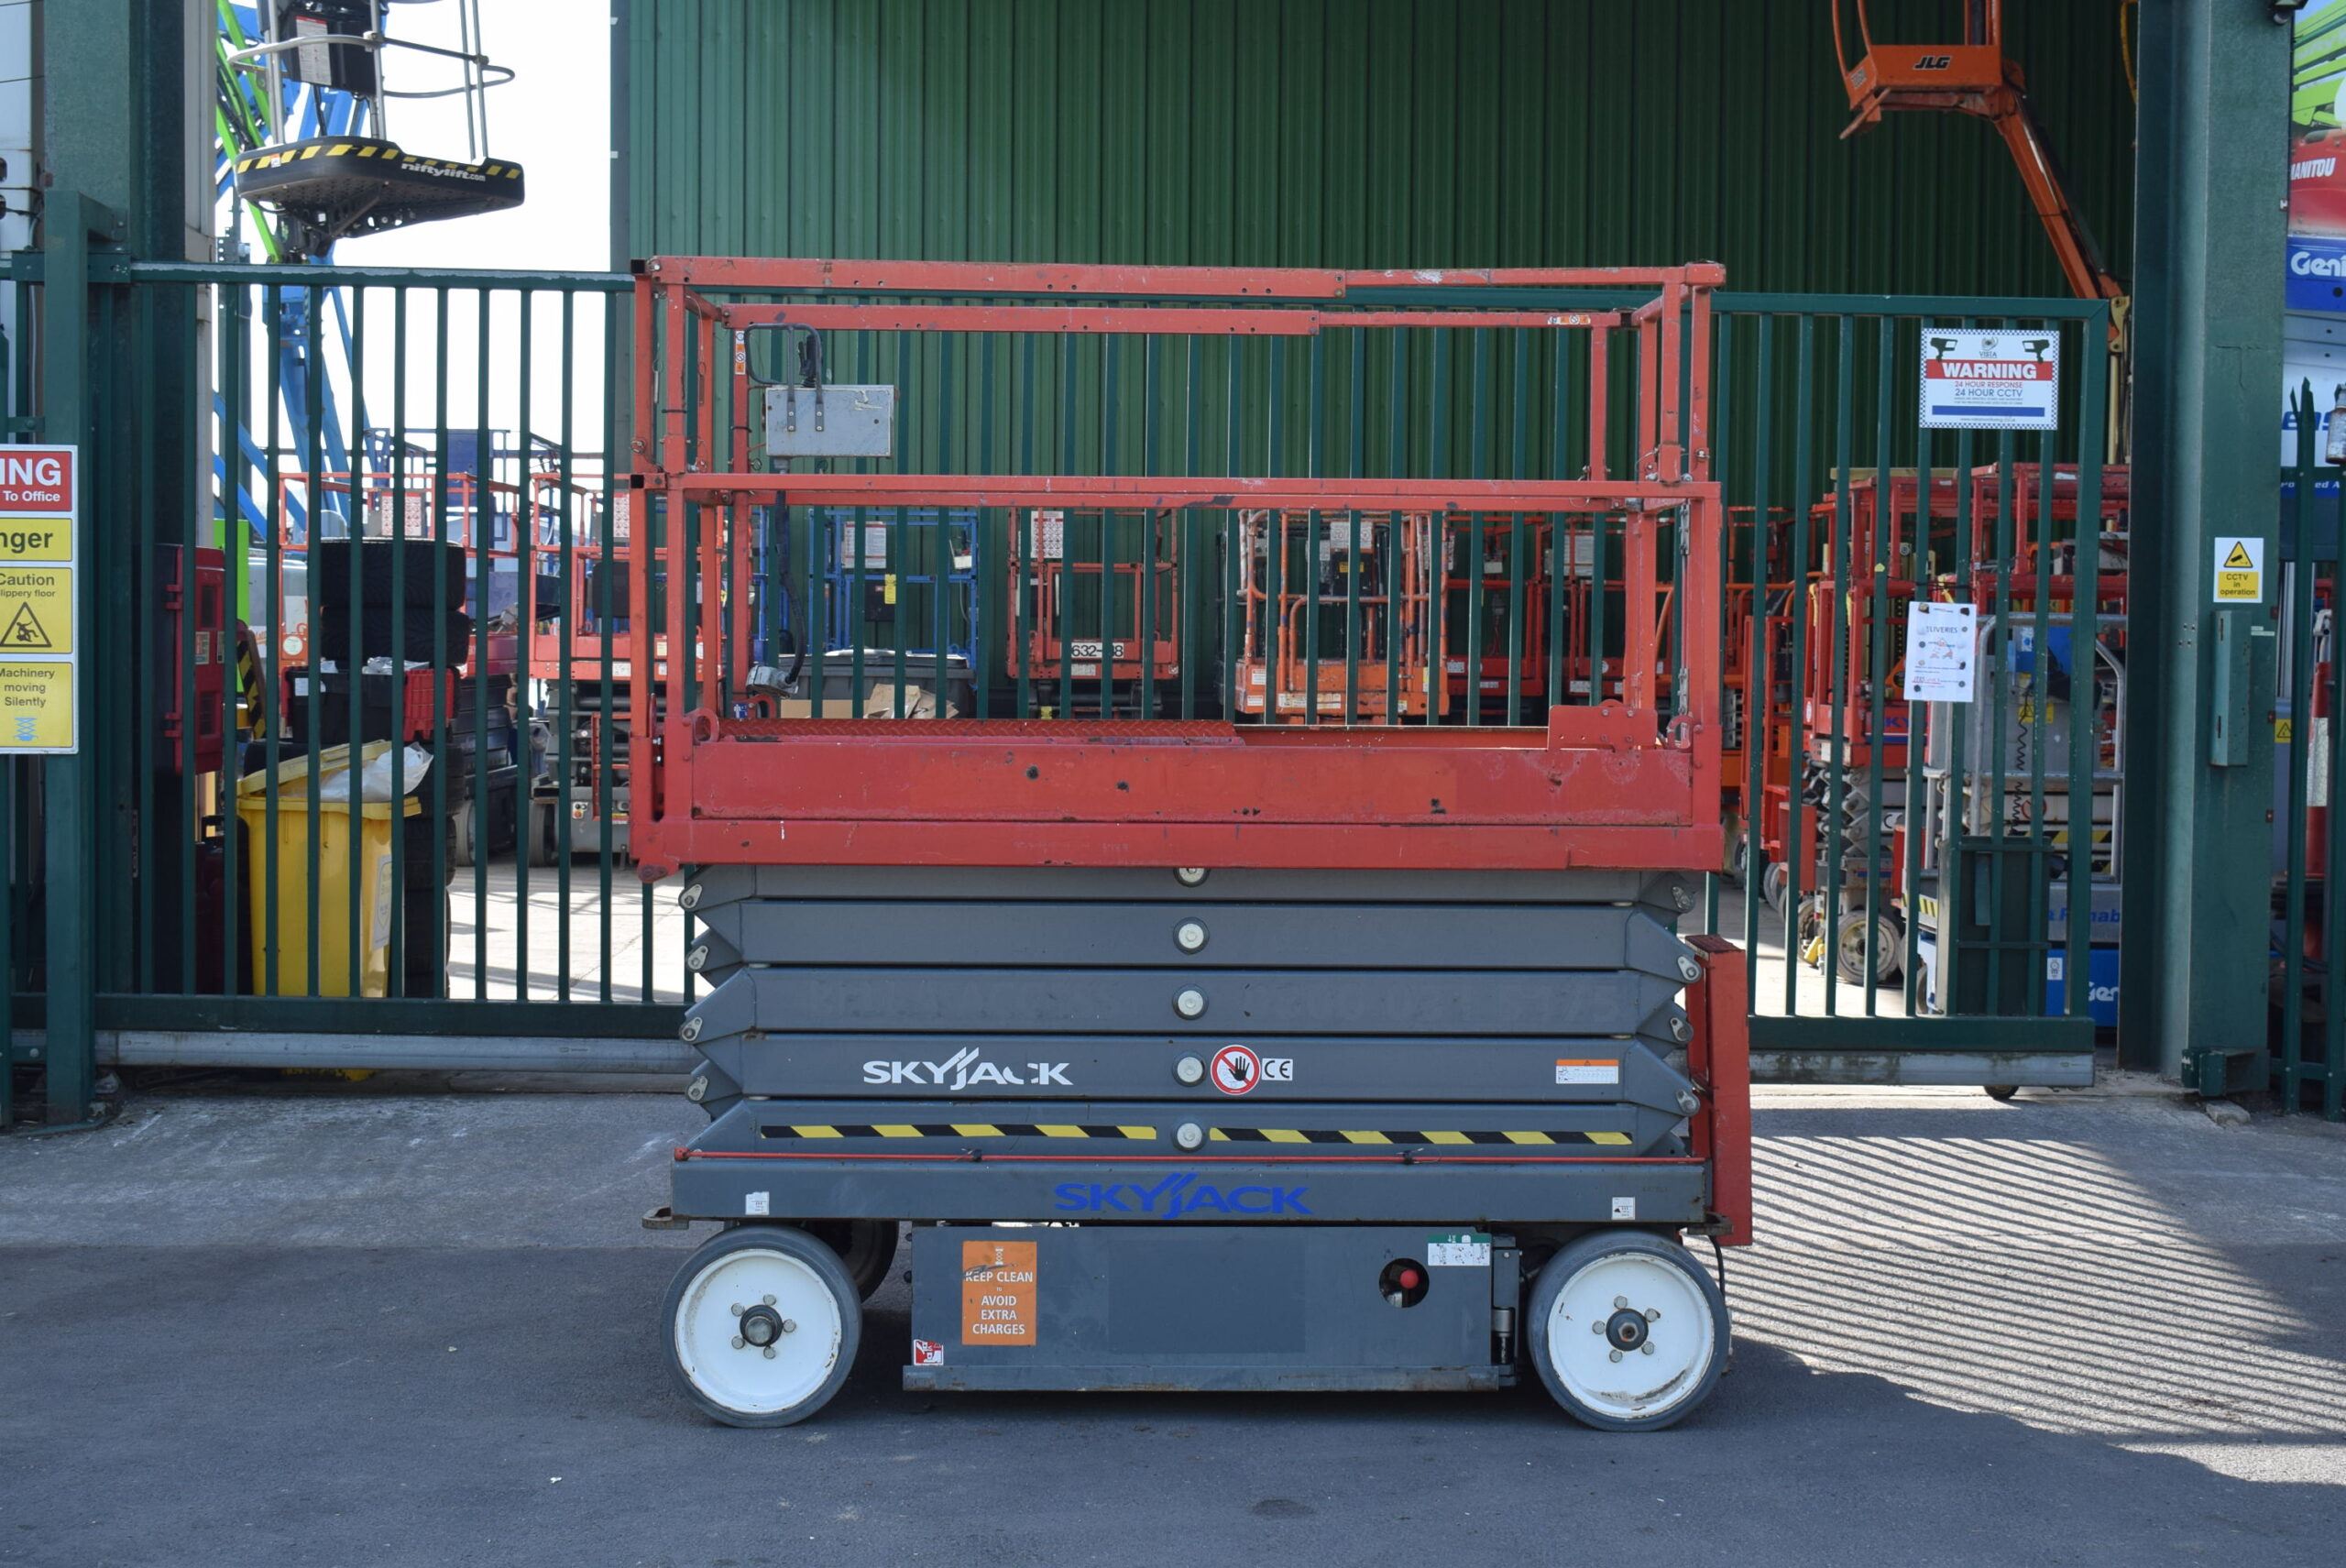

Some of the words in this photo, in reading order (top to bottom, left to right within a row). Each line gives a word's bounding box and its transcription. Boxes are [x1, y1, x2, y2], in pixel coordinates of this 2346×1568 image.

[1913, 56, 1951, 70] JLG
[400, 162, 486, 182] niftylift.com
[1943, 362, 2037, 379] WARNING
[1968, 389, 1994, 397] HOUR
[1997, 389, 2023, 397] CCTV
[3, 490, 18, 501] To
[22, 489, 60, 501] Office
[0, 574, 55, 587] Caution
[2226, 573, 2249, 581] CCTV
[34, 589, 56, 598] floor
[2220, 588, 2256, 597] operation
[4, 683, 46, 694] moving
[5, 696, 47, 707] Silently
[1264, 1059, 1291, 1079] CE
[1054, 1172, 1315, 1220] SKYJACK
[965, 1271, 993, 1282] KEEP
[996, 1271, 1033, 1282] CLEAN
[981, 1295, 1017, 1306] AVOID
[981, 1309, 1017, 1321] EXTRA
[972, 1323, 1025, 1334] CHARGES
